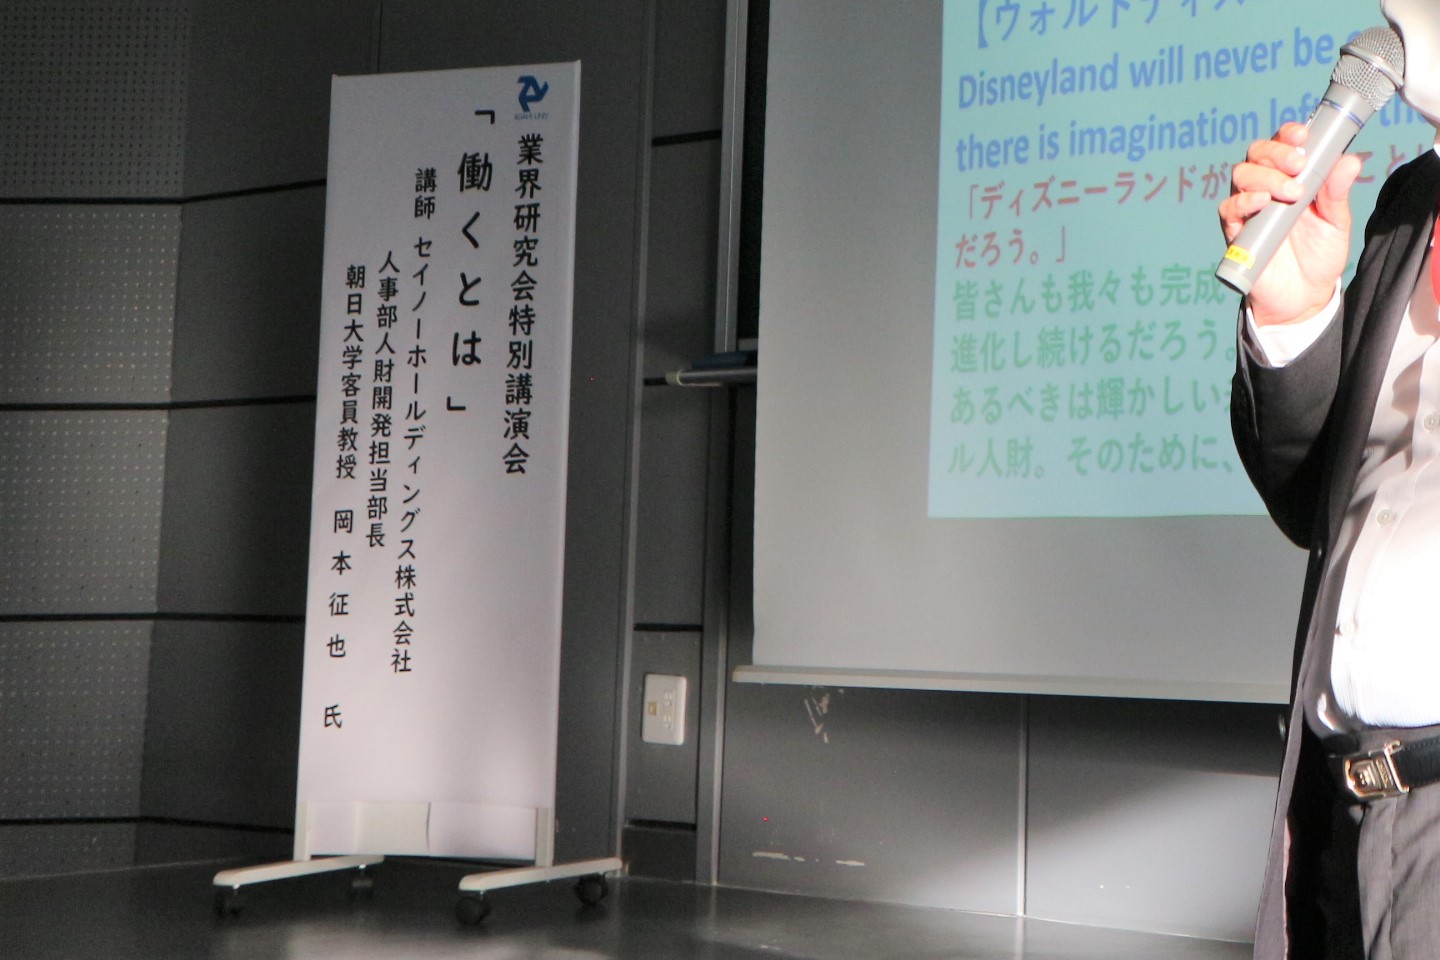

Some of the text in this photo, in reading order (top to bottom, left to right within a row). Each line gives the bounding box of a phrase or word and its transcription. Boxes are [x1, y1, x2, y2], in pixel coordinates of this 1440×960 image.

[956, 131, 1030, 172] there
[1038, 123, 1061, 161] is
[1069, 105, 1259, 162] imagination
[958, 52, 1119, 110] Disneyland
[1129, 44, 1184, 88] will
[1194, 38, 1284, 81] never
[1294, 26, 1335, 67] be
[413, 166, 437, 220] 講師
[335, 264, 366, 480] 朝日大学客員教授
[502, 132, 544, 475] 業界研究会特別講演会
[365, 250, 400, 548] 人事部人財開発担当部長
